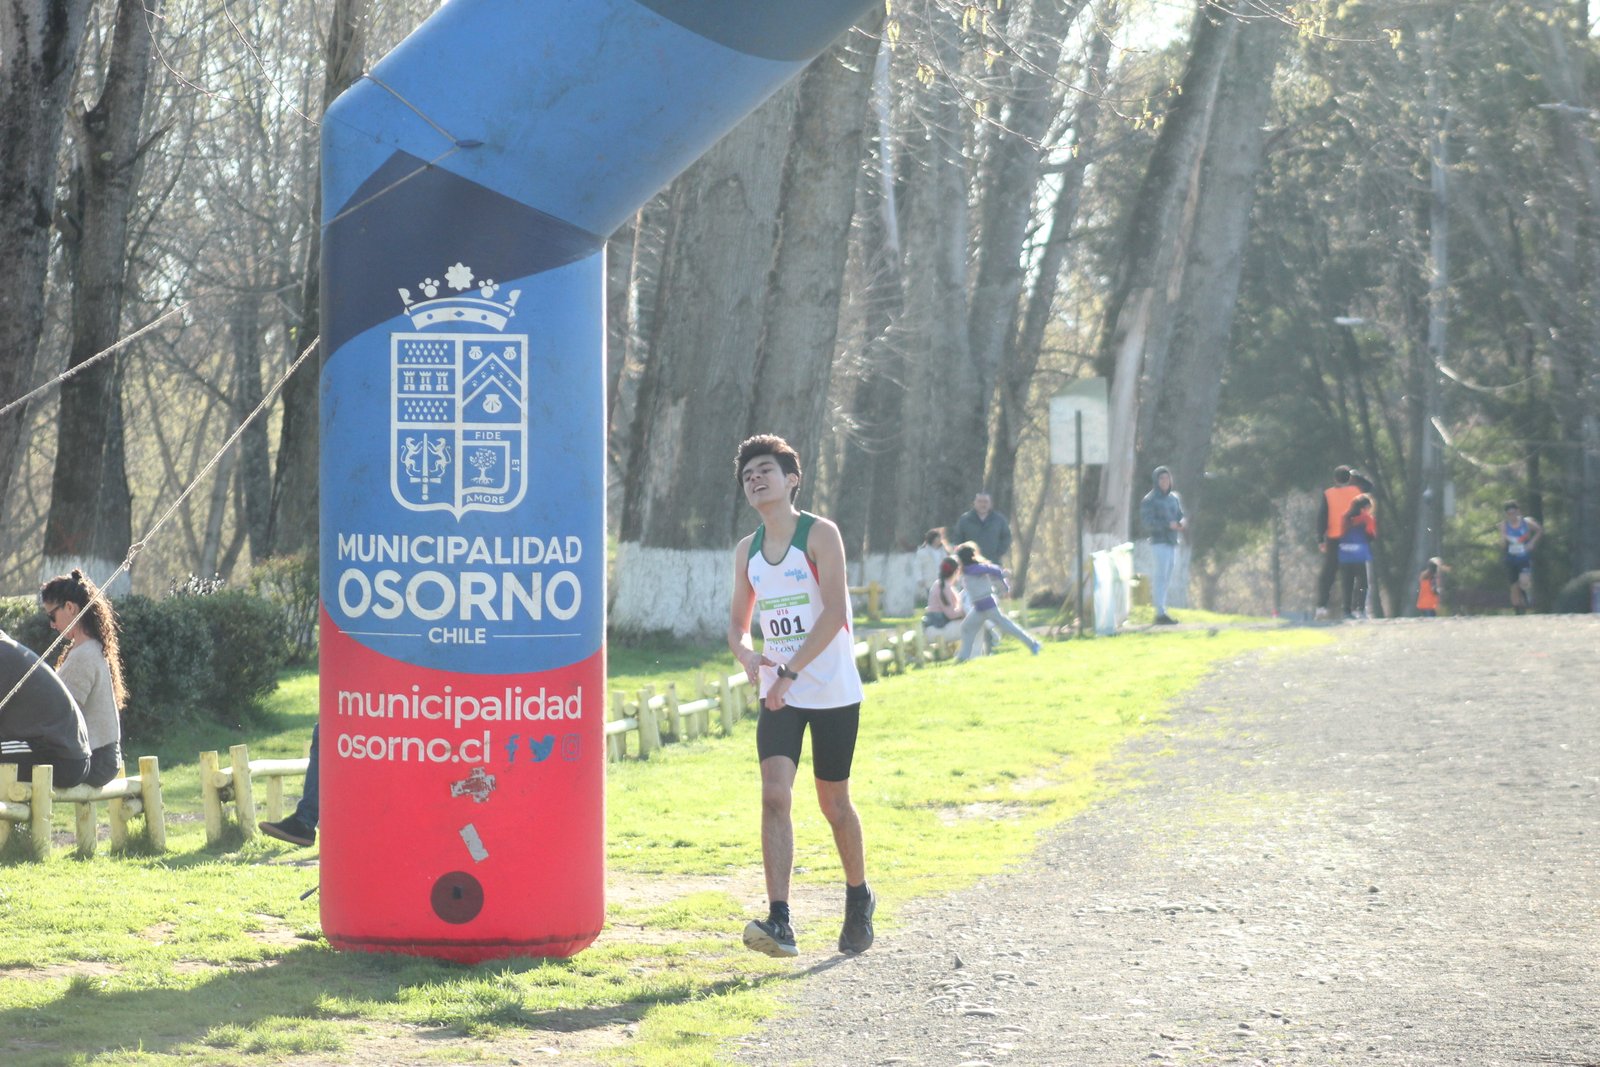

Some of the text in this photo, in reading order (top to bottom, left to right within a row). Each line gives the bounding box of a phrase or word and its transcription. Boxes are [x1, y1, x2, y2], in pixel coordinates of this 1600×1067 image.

[475, 431, 501, 440] FIDE
[512, 459, 520, 472] ET
[466, 494, 505, 504] AMORE
[338, 533, 582, 564] MUNICIPALIDAD
[338, 568, 582, 621] OSORNO
[428, 627, 486, 644] CHILE
[770, 615, 805, 636] 001
[338, 685, 582, 729] municipalidad
[338, 730, 490, 763] osorno.cl
